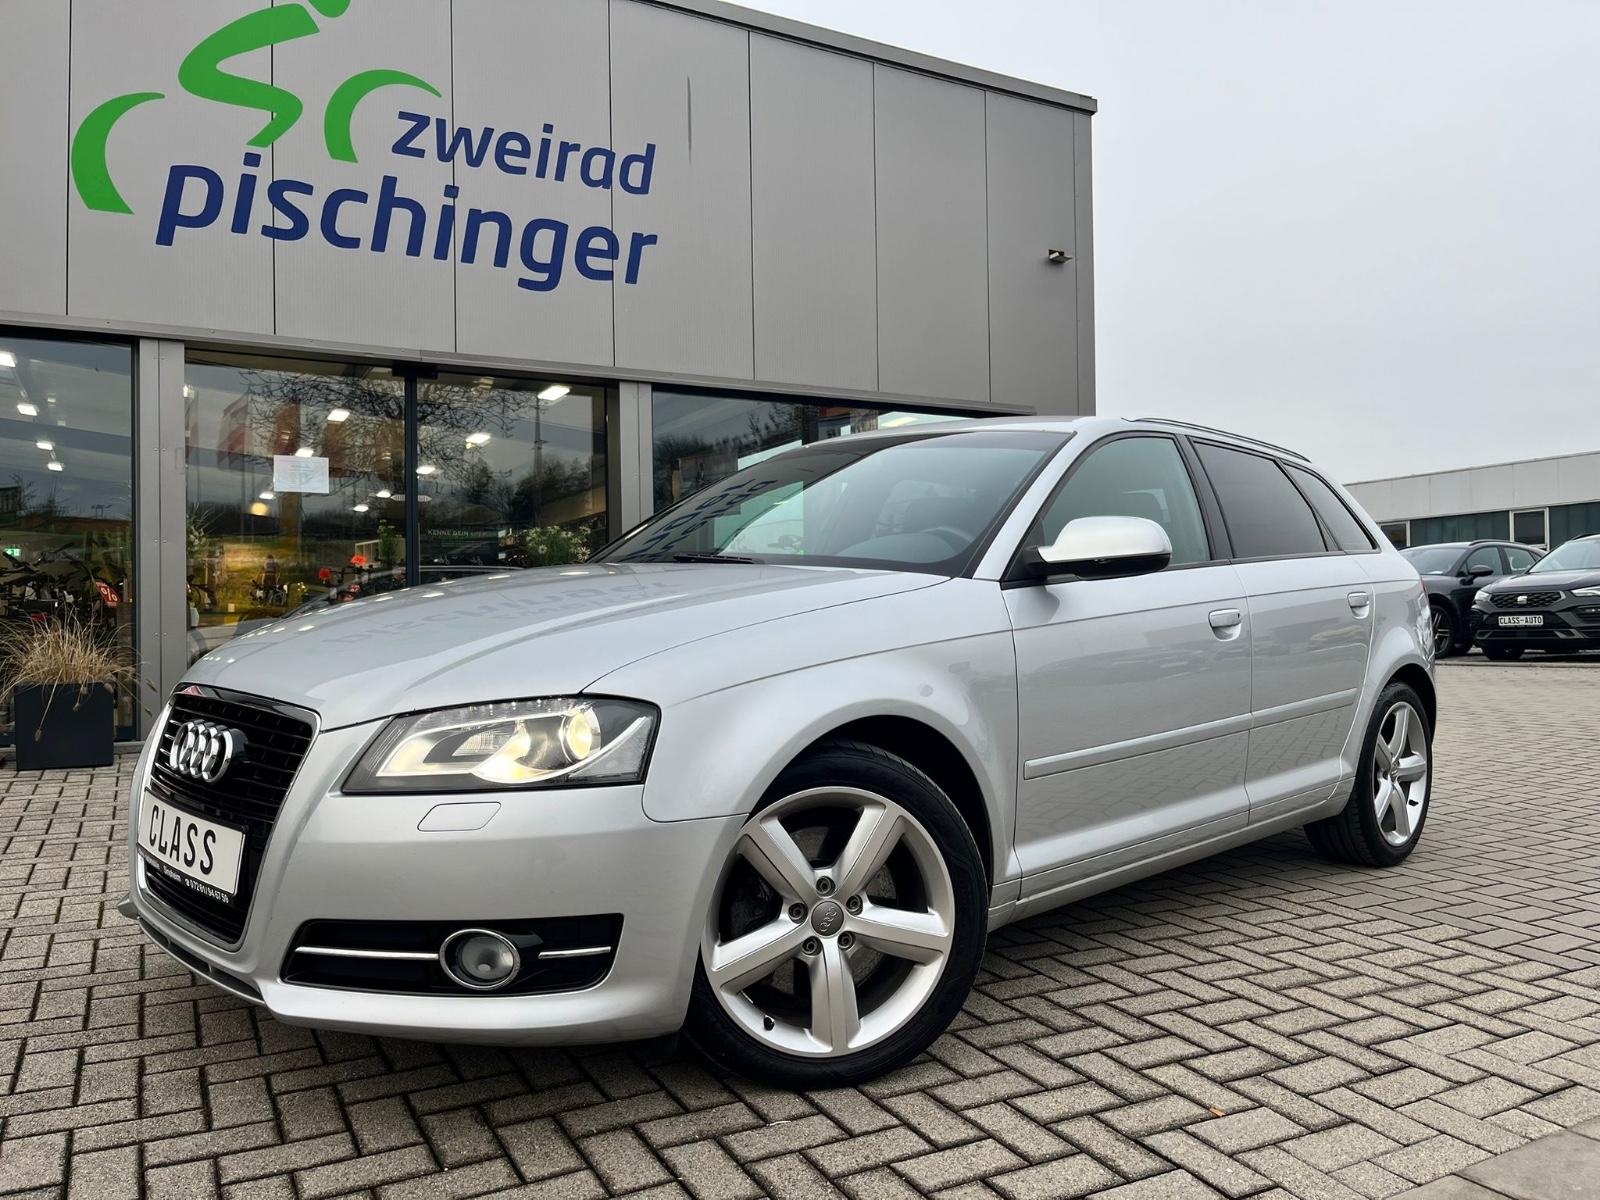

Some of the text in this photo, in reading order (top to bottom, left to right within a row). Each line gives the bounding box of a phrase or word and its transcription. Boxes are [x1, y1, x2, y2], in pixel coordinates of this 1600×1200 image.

[393, 111, 656, 195] zweirad
[156, 153, 658, 292] pischinger
[1499, 616, 1542, 624] CLASS-AUTO
[149, 804, 217, 875] CLASS
